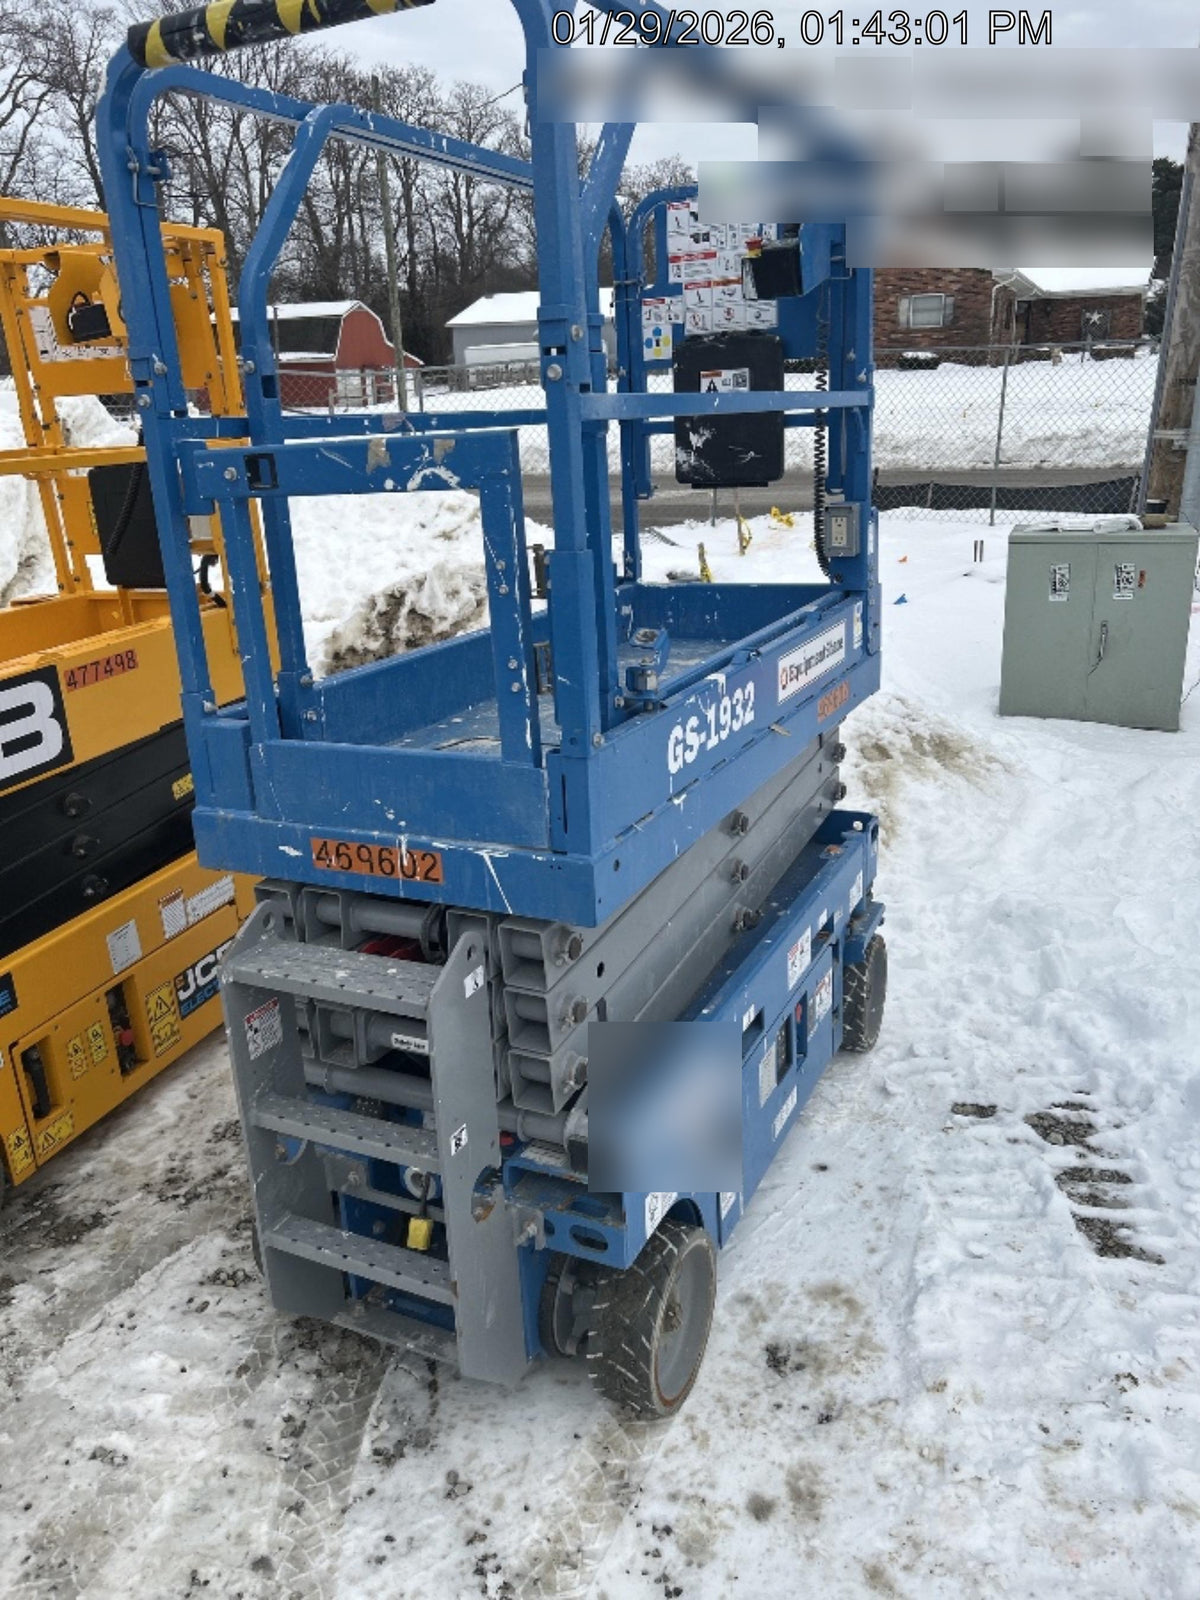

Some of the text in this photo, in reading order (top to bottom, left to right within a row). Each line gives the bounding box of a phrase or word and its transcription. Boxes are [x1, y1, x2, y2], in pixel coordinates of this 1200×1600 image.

[66, 650, 137, 690] 477498
[667, 681, 756, 774] GS-1932
[316, 840, 440, 882] 469602
